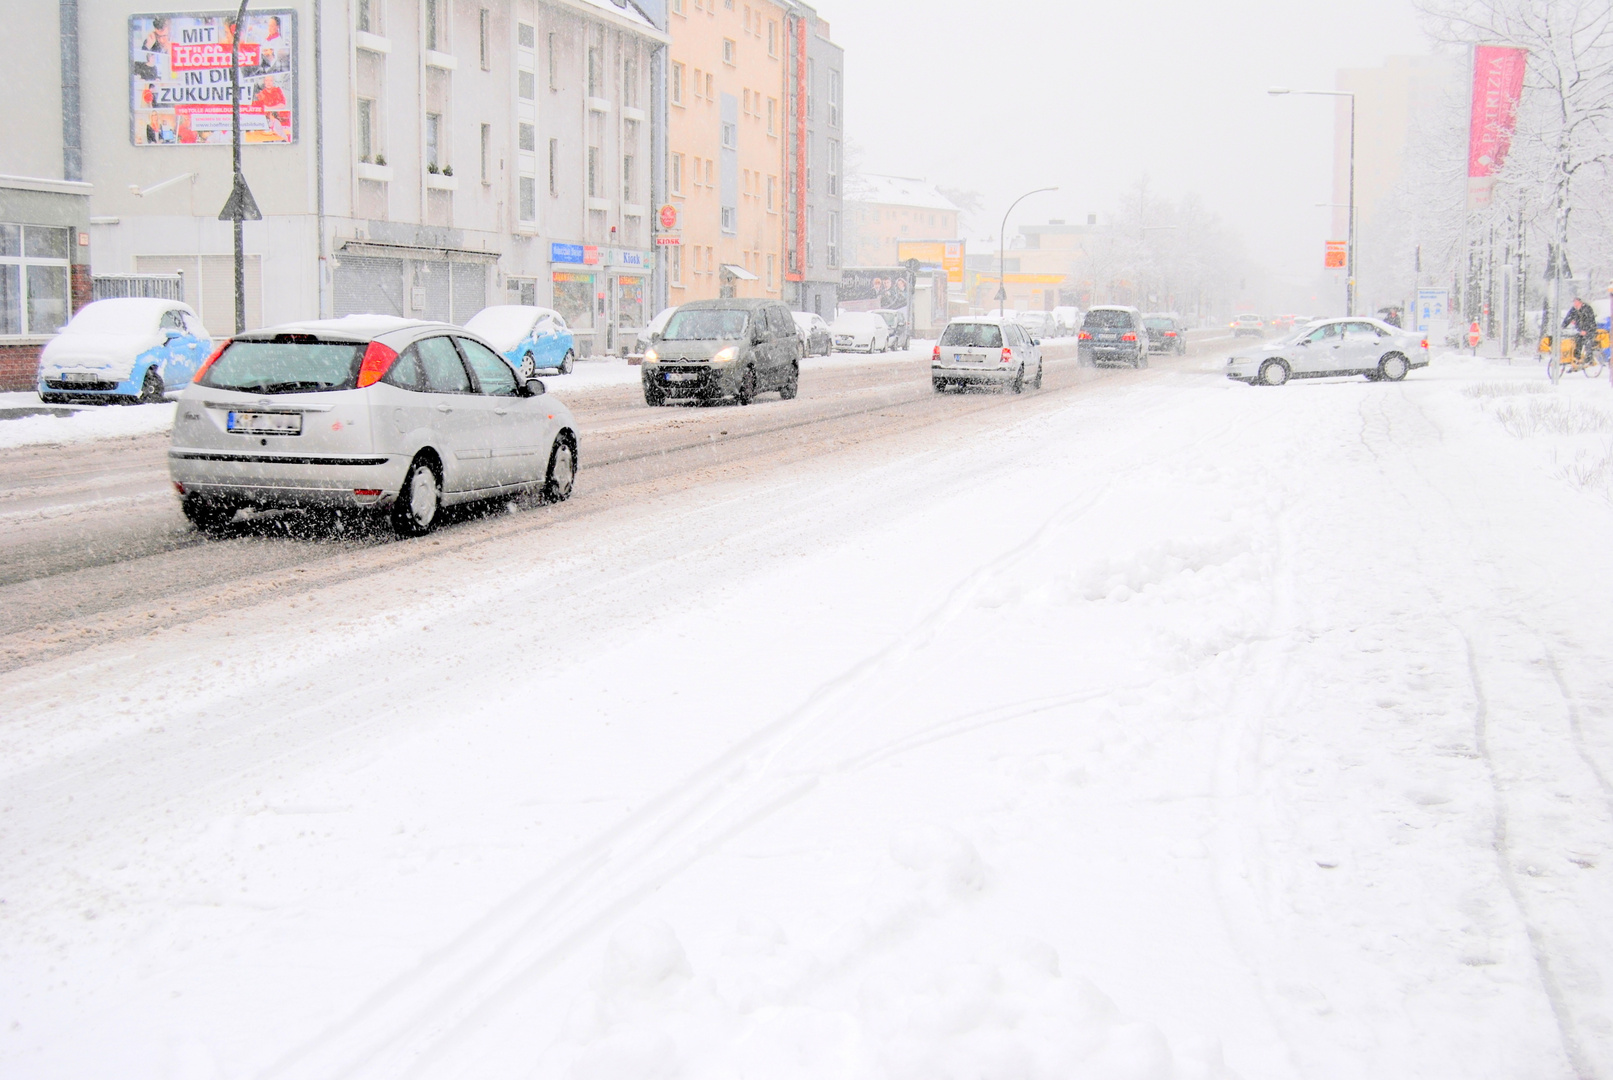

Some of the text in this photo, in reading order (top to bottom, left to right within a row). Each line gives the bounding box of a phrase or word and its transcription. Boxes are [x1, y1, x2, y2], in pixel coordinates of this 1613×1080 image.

[182, 27, 214, 44] MIT
[173, 45, 257, 67] Höffner
[185, 71, 203, 86] IN
[1482, 56, 1505, 144] PATRIZIA
[623, 252, 641, 265] Kiosk
